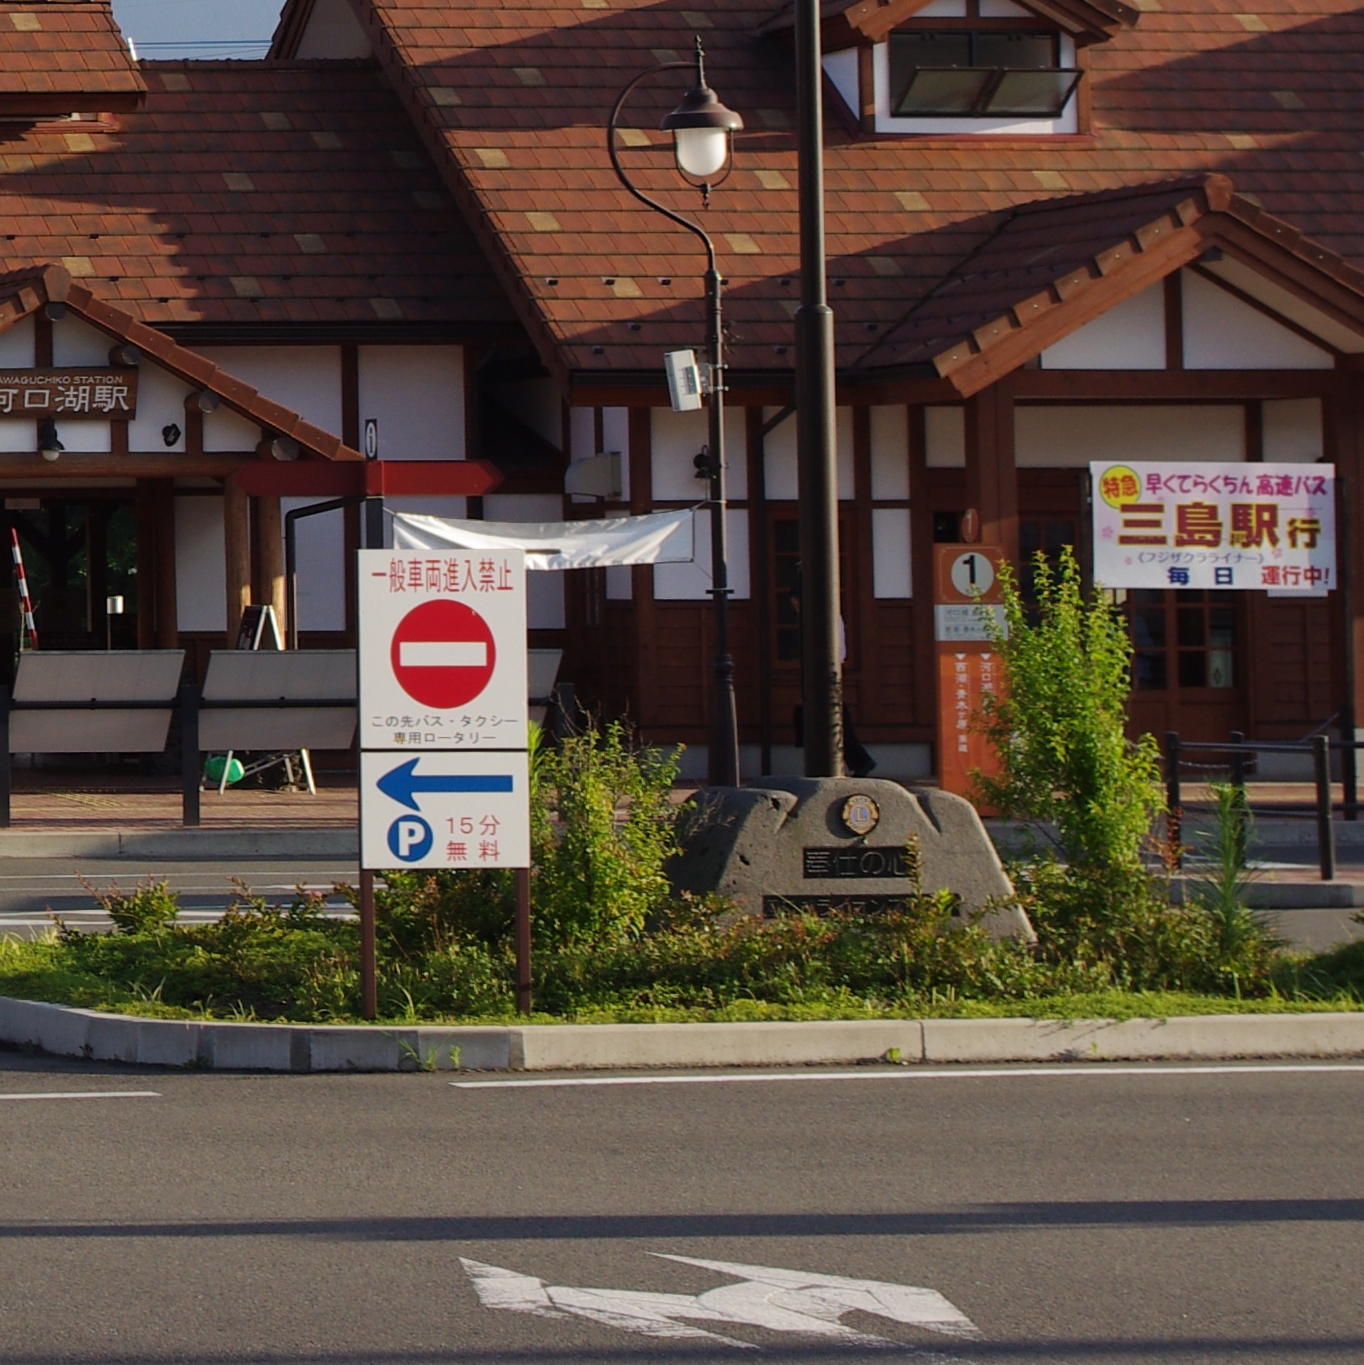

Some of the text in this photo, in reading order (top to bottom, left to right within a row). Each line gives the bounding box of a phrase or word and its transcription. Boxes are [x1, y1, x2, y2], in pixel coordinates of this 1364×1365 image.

[73, 375, 123, 385] STATION
[1101, 474, 1139, 499] 特急
[1117, 501, 1321, 549] 三島駅行
[371, 557, 514, 594] 一般車両進入禁止
[962, 554, 976, 585] 1
[1261, 565, 1330, 587] 運行中!
[371, 714, 519, 728] この先バス・タクシー
[393, 730, 497, 745] 専用ロータリー
[445, 814, 501, 836] 15分
[855, 806, 867, 822] L
[398, 820, 425, 857] P
[446, 839, 501, 863] 無料
